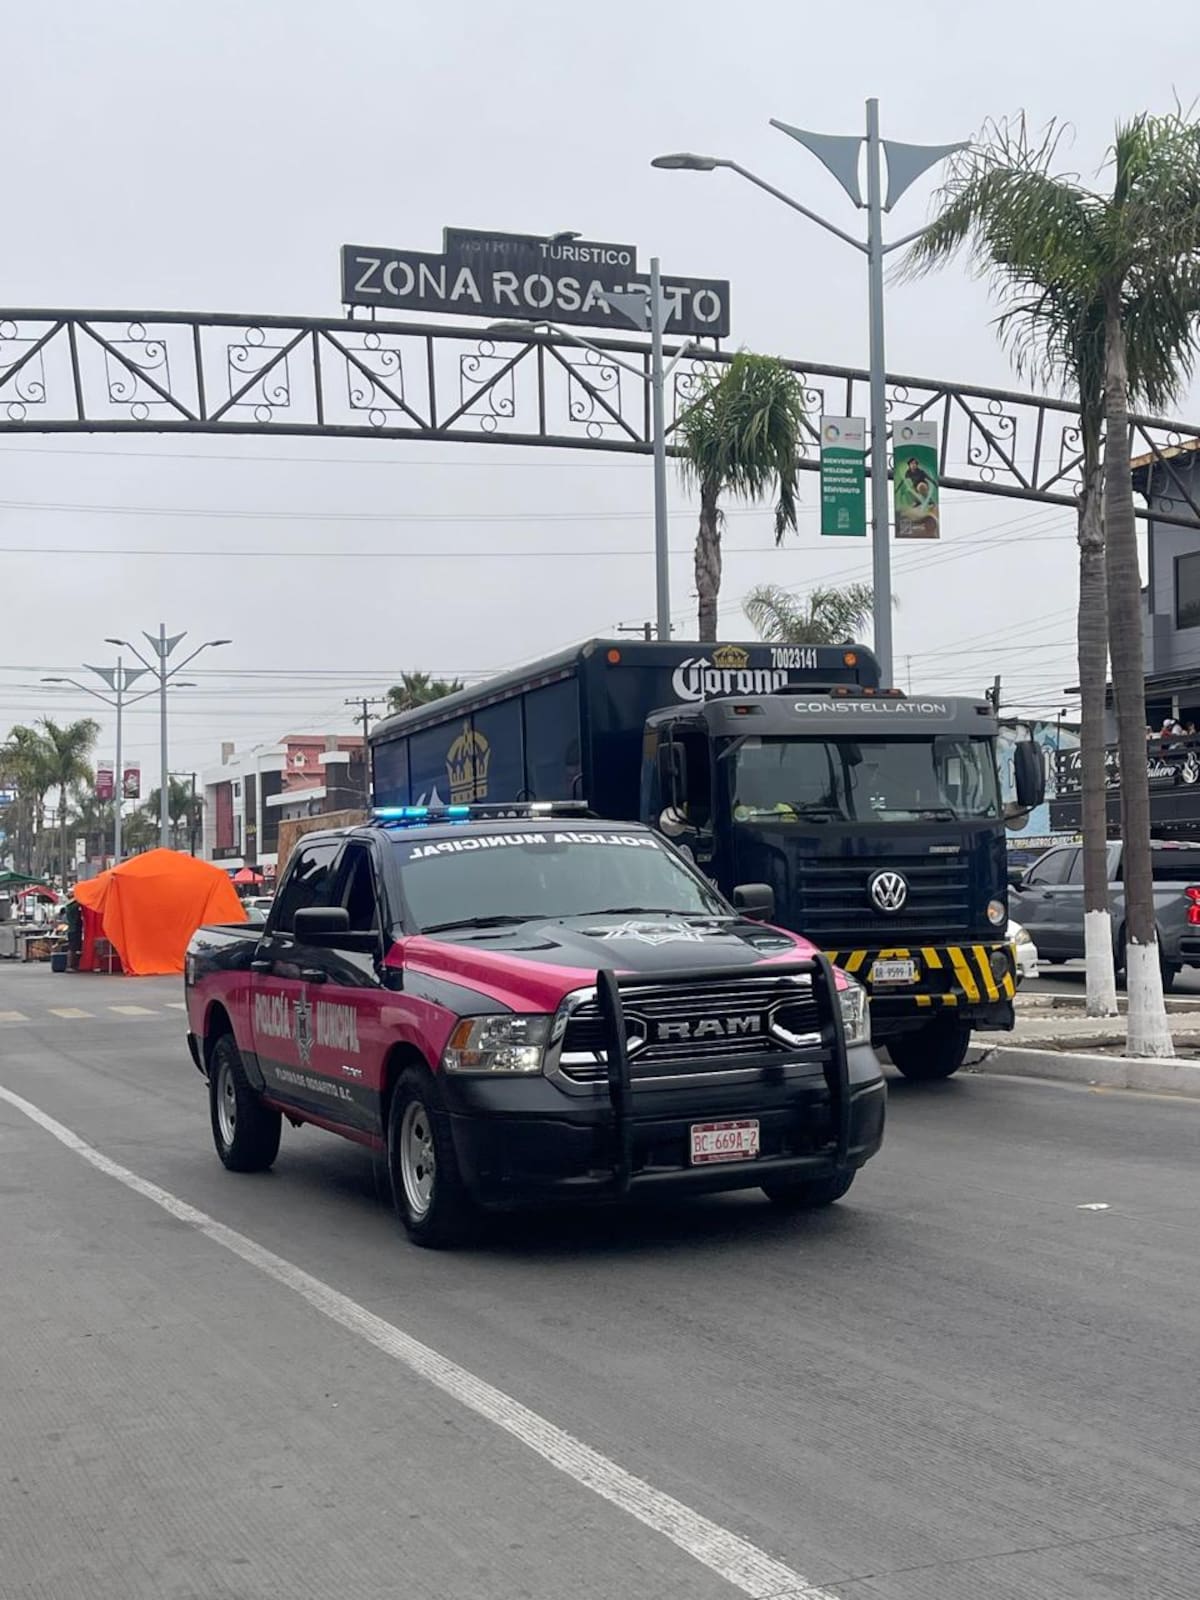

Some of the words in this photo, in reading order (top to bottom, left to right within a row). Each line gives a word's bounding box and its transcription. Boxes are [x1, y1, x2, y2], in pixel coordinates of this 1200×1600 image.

[538, 243, 631, 266] TURISTICO
[353, 255, 482, 304] ZONA
[770, 647, 818, 669] 70023141
[794, 702, 946, 713] CONSTELLATION
[658, 1015, 761, 1039] RAM
